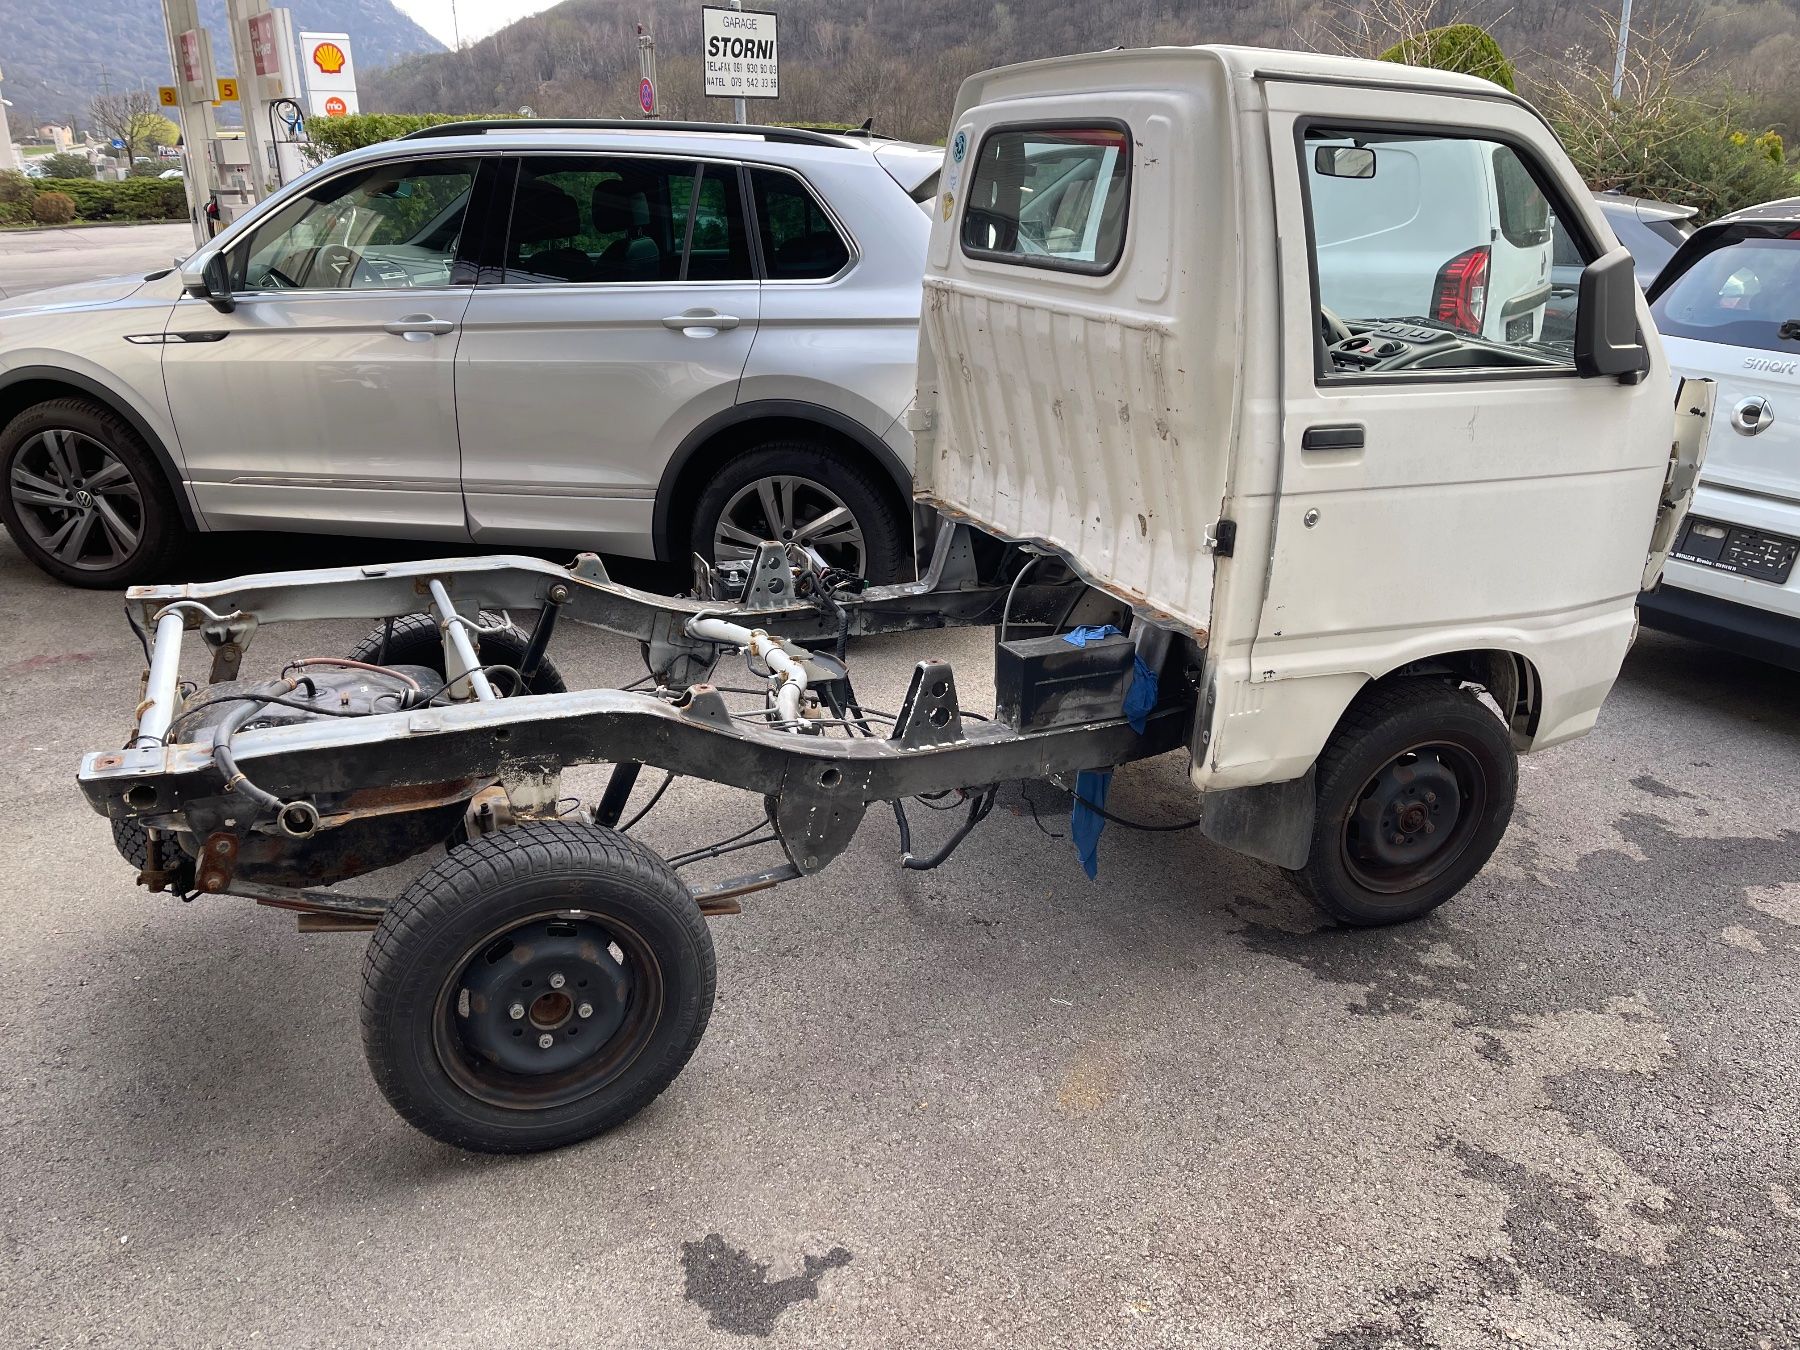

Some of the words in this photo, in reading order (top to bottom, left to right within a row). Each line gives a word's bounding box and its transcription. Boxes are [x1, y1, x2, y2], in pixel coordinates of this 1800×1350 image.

[723, 16, 757, 30] GARAGE
[708, 36, 774, 59] STORNI
[707, 77, 725, 87] NATEL
[747, 78, 758, 88] 542
[163, 91, 173, 103] 3
[223, 83, 233, 97] 5
[1742, 356, 1798, 376] smart
